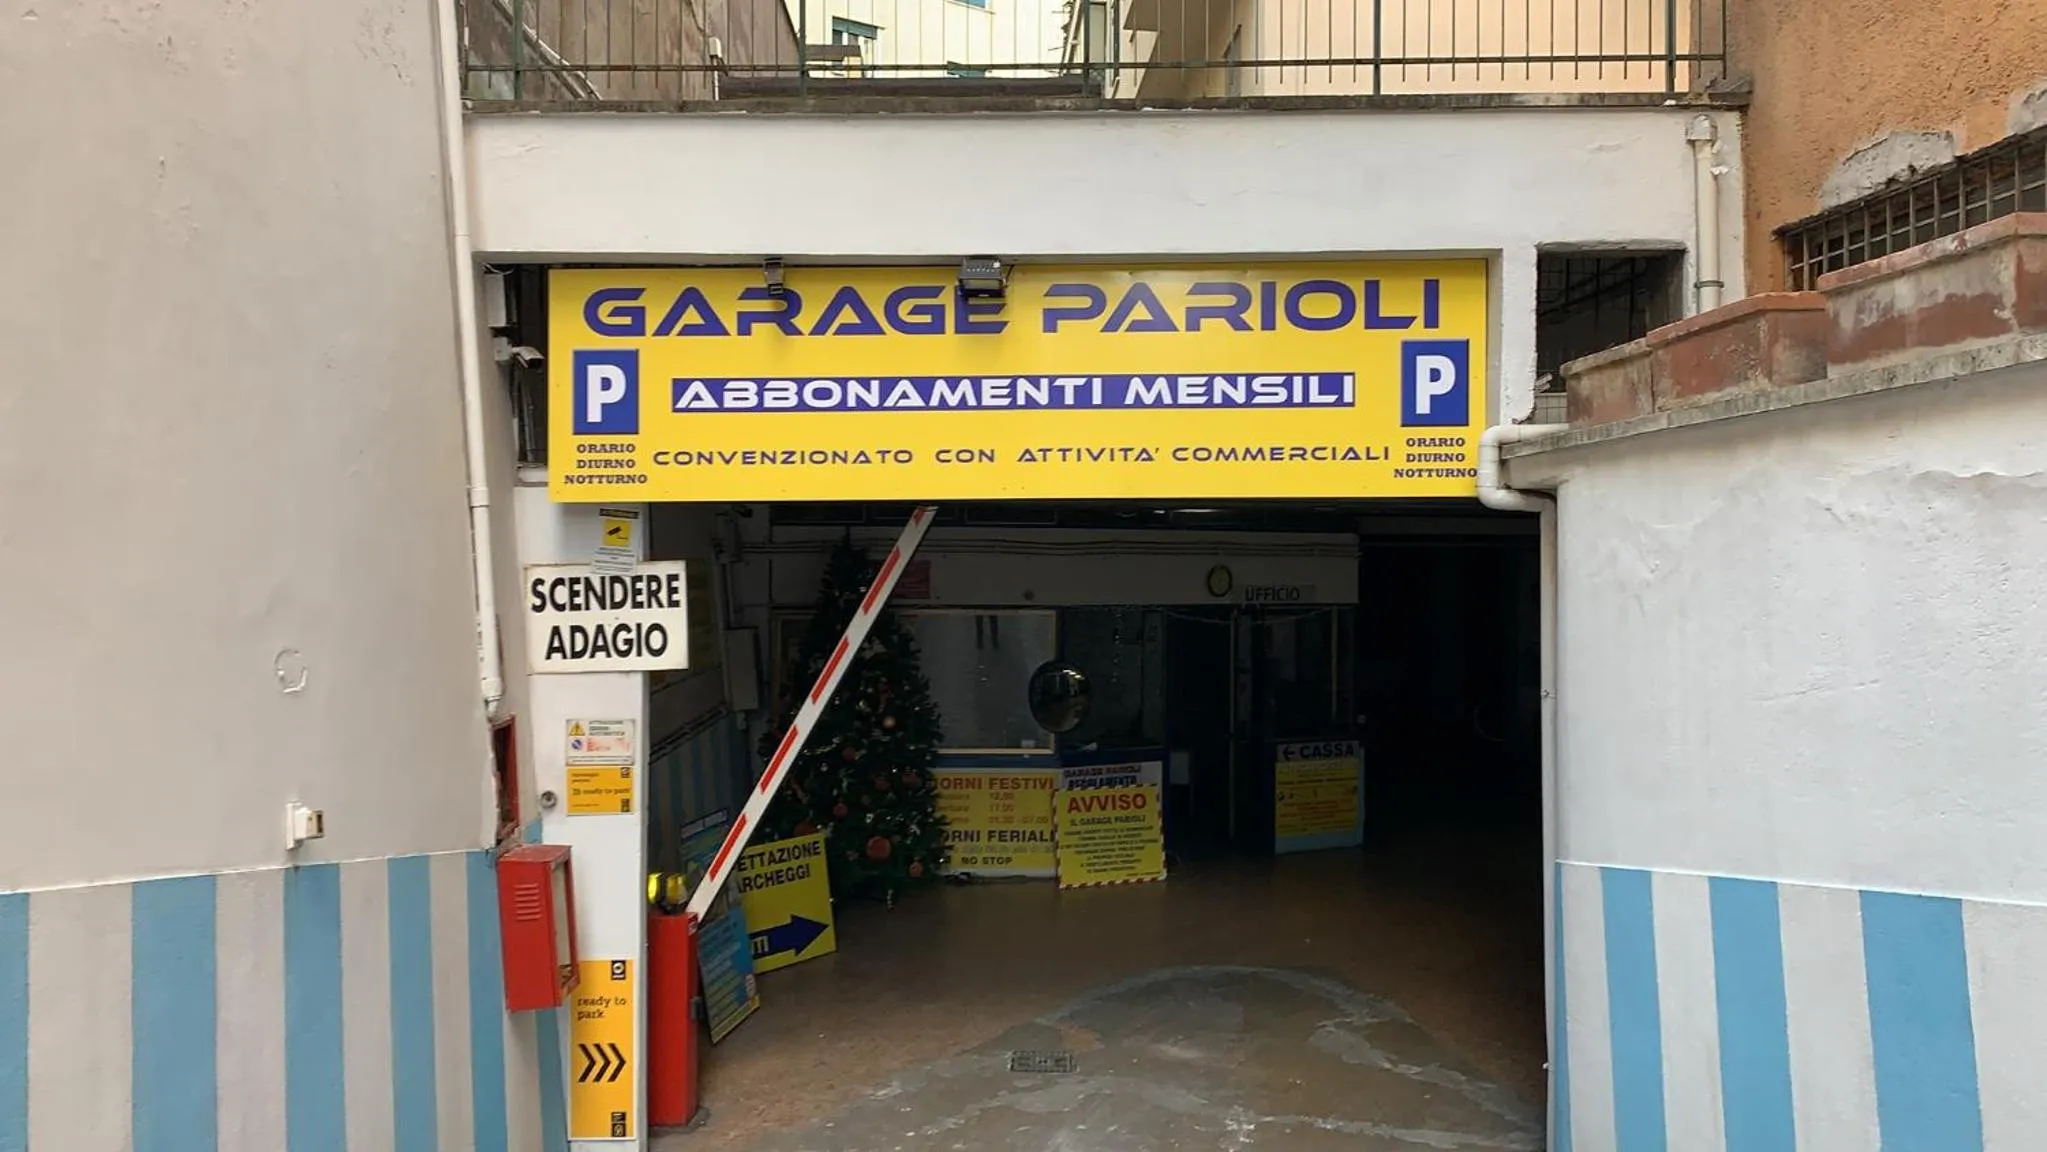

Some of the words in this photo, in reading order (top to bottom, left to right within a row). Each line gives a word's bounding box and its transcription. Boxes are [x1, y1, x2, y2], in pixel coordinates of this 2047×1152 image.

[583, 286, 1010, 337] GARAGE
[1042, 279, 1440, 333] PARIOLI
[674, 378, 1102, 409] ABBONAMENTI
[1124, 374, 1354, 405] MENSILI
[1415, 355, 1456, 414] P
[586, 364, 626, 422] P
[576, 443, 636, 454] ORARIO
[1405, 437, 1466, 448] ORARIO
[653, 449, 913, 465] CONVENZIONATO
[935, 448, 996, 464] CON
[1017, 446, 1160, 463] ATTIVITA'
[1172, 446, 1390, 462] COMMERCIALI
[1405, 452, 1466, 463] DIURNO
[576, 458, 636, 469] DIURNO
[564, 474, 648, 485] NOTTURNO
[1393, 467, 1478, 479] NOTTURNO
[531, 573, 681, 614] SCENDERE
[1244, 586, 1300, 601] UFFICIO
[545, 622, 668, 660] ADAGIO
[1299, 742, 1354, 759] CASSA
[940, 777, 982, 790] ORNI
[989, 777, 1053, 790] FESTIVI
[1067, 793, 1147, 814] AVVISO
[987, 829, 1054, 843] FERIALI
[737, 840, 821, 872] ETTAZIONE
[982, 856, 1013, 865] STOP
[577, 996, 610, 1009] ready
[615, 996, 627, 1006] to
[577, 1009, 605, 1022] park
